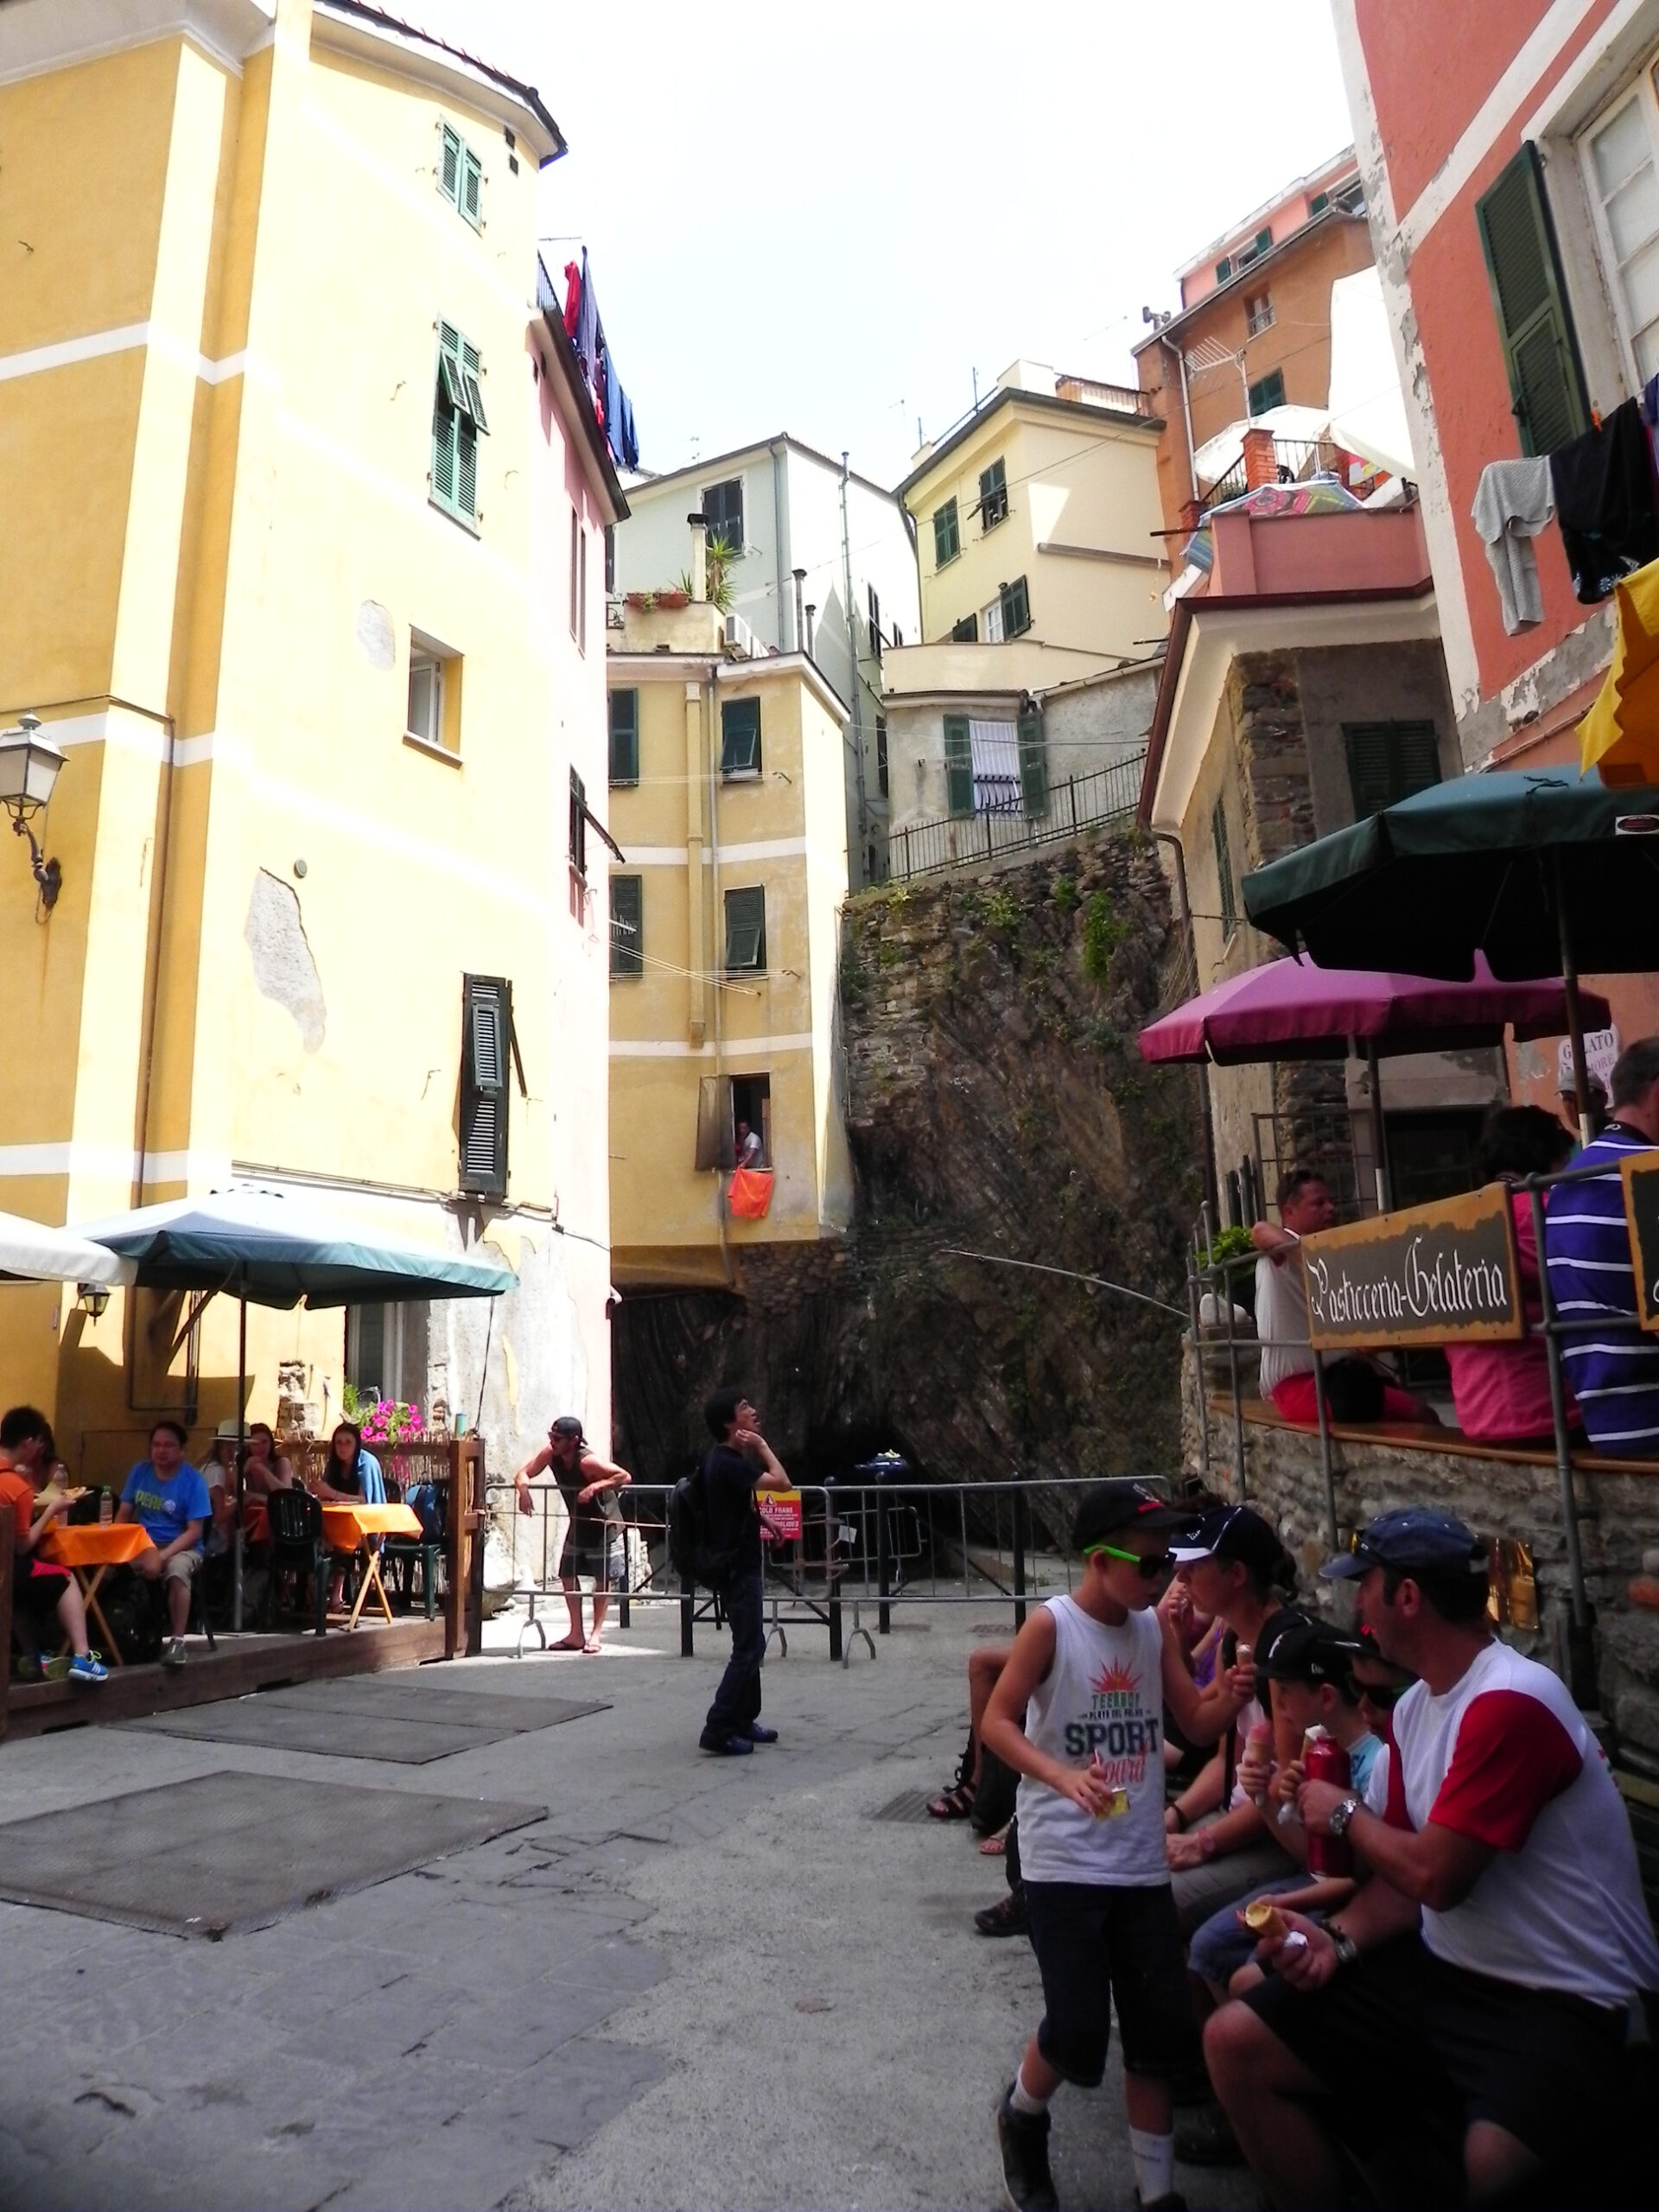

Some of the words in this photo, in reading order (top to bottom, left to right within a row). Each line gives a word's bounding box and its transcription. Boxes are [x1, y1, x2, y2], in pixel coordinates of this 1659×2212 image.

[1563, 1033, 1614, 1059] GATO
[1306, 1233, 1508, 1324] Pasticceria-Gelateria
[1065, 1719, 1158, 1756] SPORT
